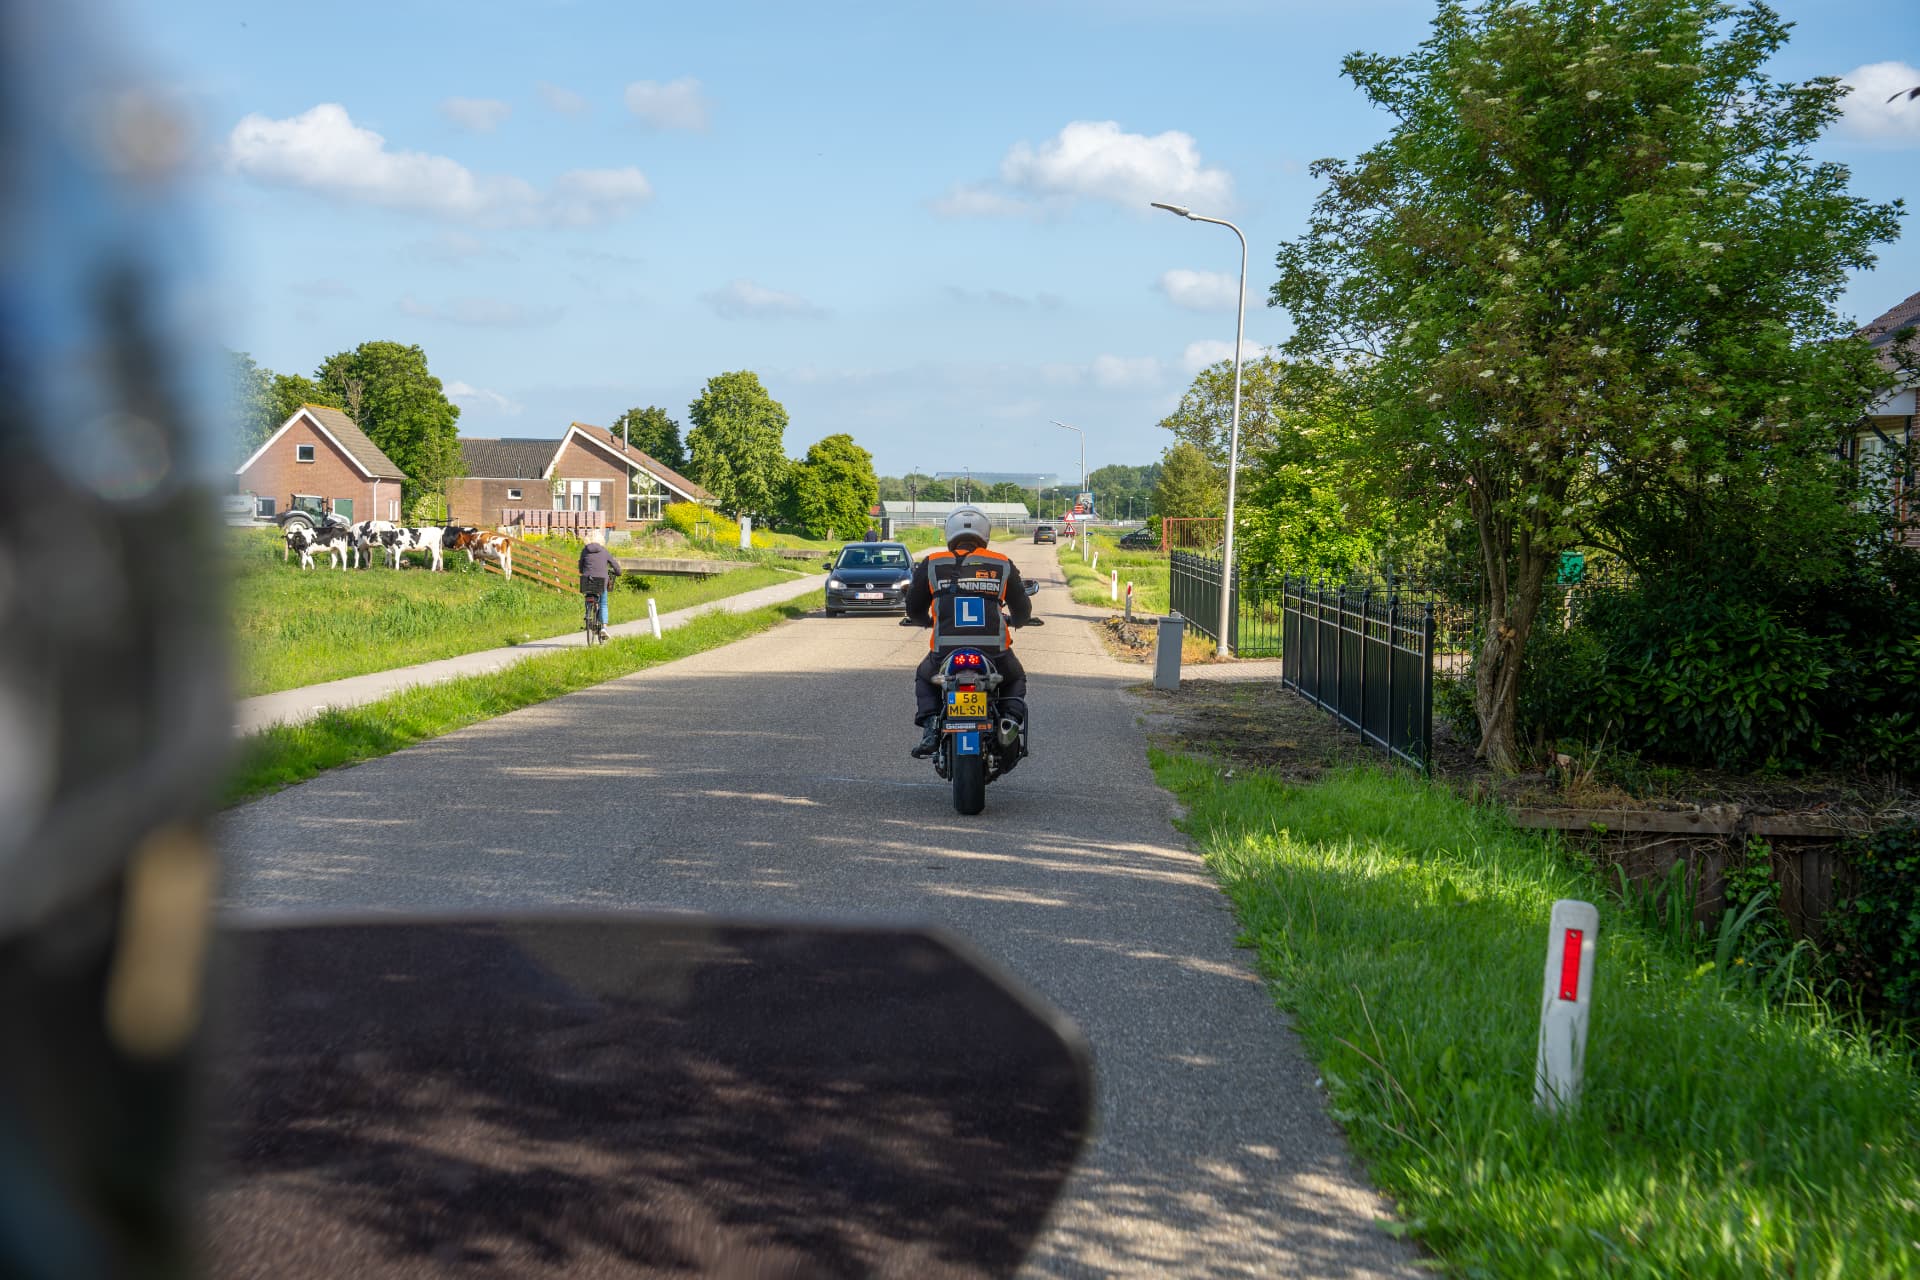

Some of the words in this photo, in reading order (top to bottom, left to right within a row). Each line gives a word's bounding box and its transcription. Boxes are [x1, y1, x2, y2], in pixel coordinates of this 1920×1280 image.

[962, 601, 978, 622] L
[963, 693, 978, 704] 58
[962, 735, 974, 751] L
